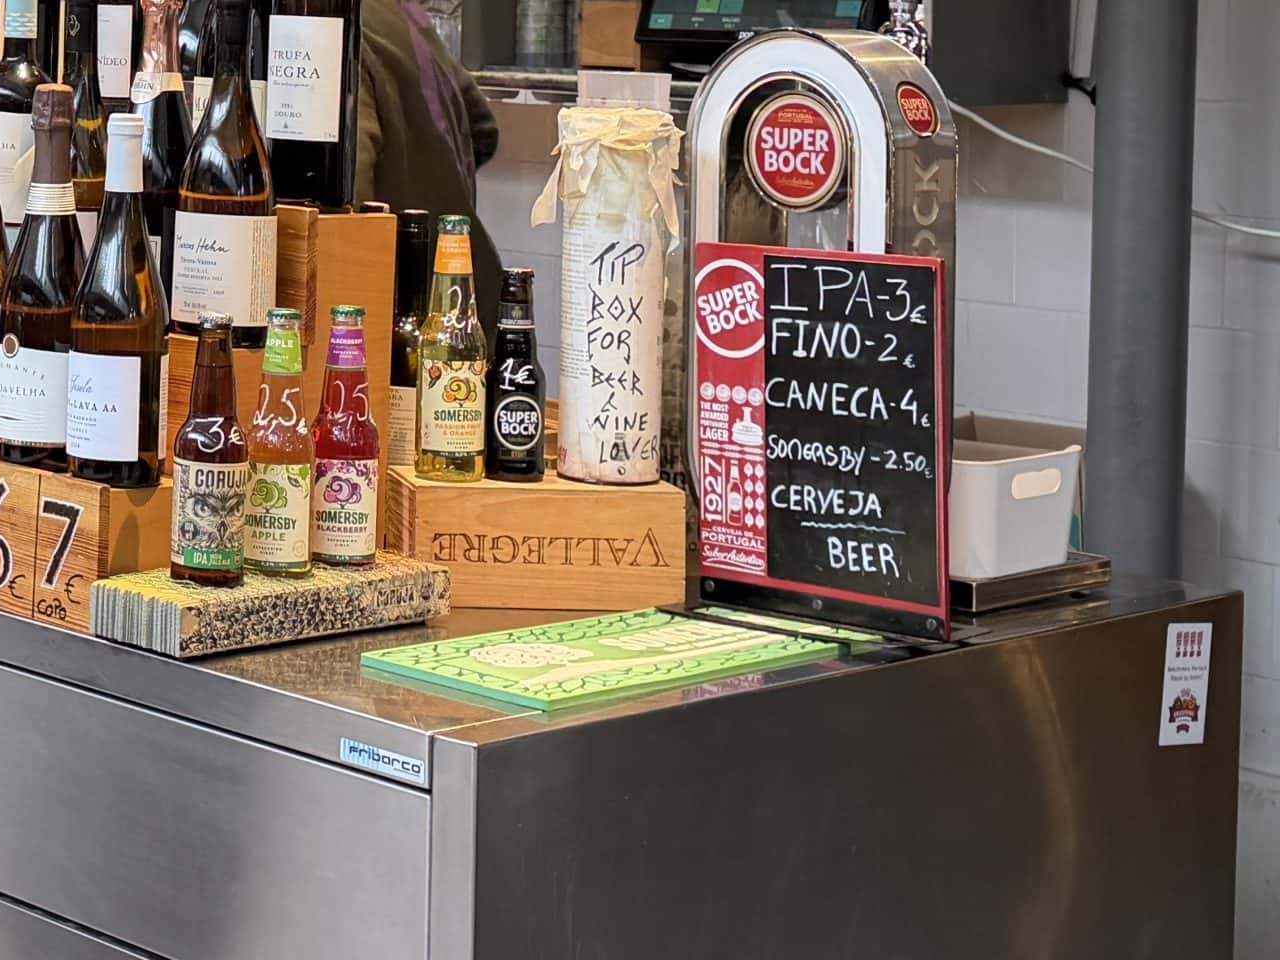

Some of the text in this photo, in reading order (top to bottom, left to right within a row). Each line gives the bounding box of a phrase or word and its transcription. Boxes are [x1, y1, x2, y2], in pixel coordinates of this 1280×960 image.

[272, 49, 312, 61] TRUFA
[901, 97, 929, 111] SUPER
[906, 108, 931, 122] BOCK
[760, 126, 830, 152] SUPER
[764, 150, 827, 175] BOCK
[586, 283, 644, 325] BOX
[697, 279, 761, 316] SUPER
[706, 299, 764, 336] BOCK
[586, 326, 632, 365] FOR
[591, 365, 644, 396] BEER
[73, 399, 98, 412] LAVA
[434, 409, 482, 423] SOMERSBY
[499, 410, 538, 425] SUPER
[501, 421, 537, 436] BOCK
[700, 427, 730, 442] LAGER
[195, 468, 248, 491] CORUJA
[704, 455, 723, 523] 1927
[770, 484, 883, 518] CERVEJA
[244, 514, 297, 530] SOMERSBY
[315, 510, 370, 525] SOMERSBY
[251, 531, 286, 542] APPLE
[317, 524, 368, 533] BLACKBERRY
[40, 495, 85, 590] 7
[431, 526, 671, 569] VALLEGRE
[701, 530, 765, 550] PORTUGAL
[193, 551, 208, 566] IPA
[827, 535, 902, 578] BEER
[348, 744, 423, 776] Fribarco
